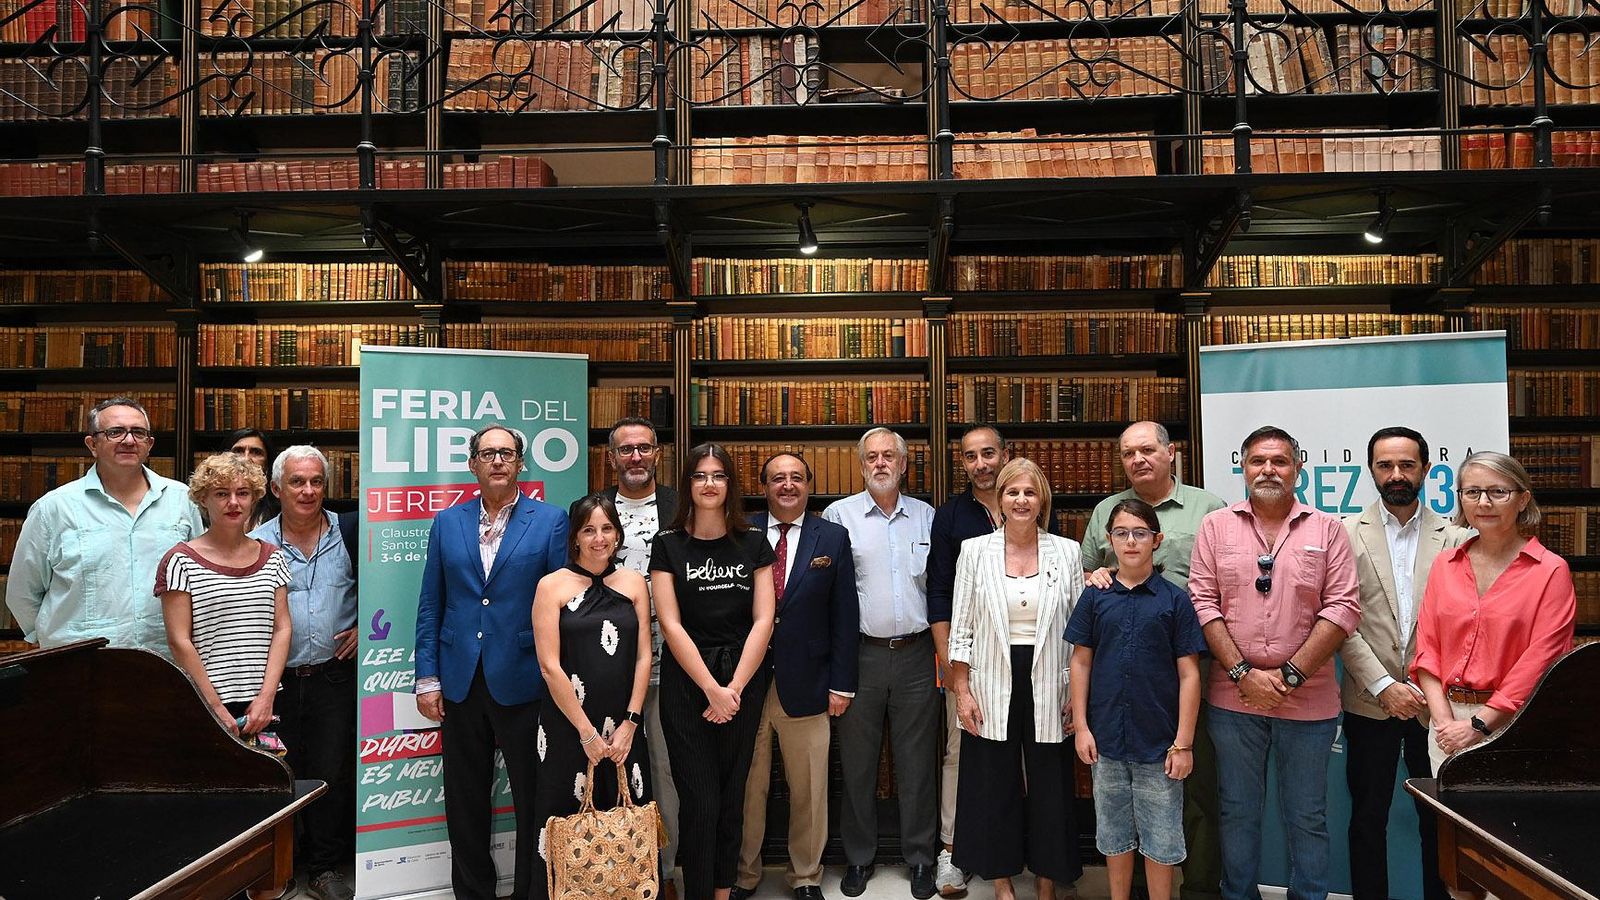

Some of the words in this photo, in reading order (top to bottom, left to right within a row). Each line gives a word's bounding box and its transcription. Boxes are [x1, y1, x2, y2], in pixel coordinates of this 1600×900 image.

[372, 388, 506, 420] FERIA
[522, 400, 578, 422] DEL
[368, 490, 464, 514] JEREZ
[381, 540, 417, 551] Santo
[380, 553, 401, 563] 3-6
[404, 553, 421, 562] de
[686, 557, 748, 581] believe
[362, 647, 405, 666] LEE
[363, 669, 416, 692] QUIE
[359, 731, 439, 757] DIARIO
[360, 763, 394, 785] ES
[361, 788, 432, 812] PUBLI
